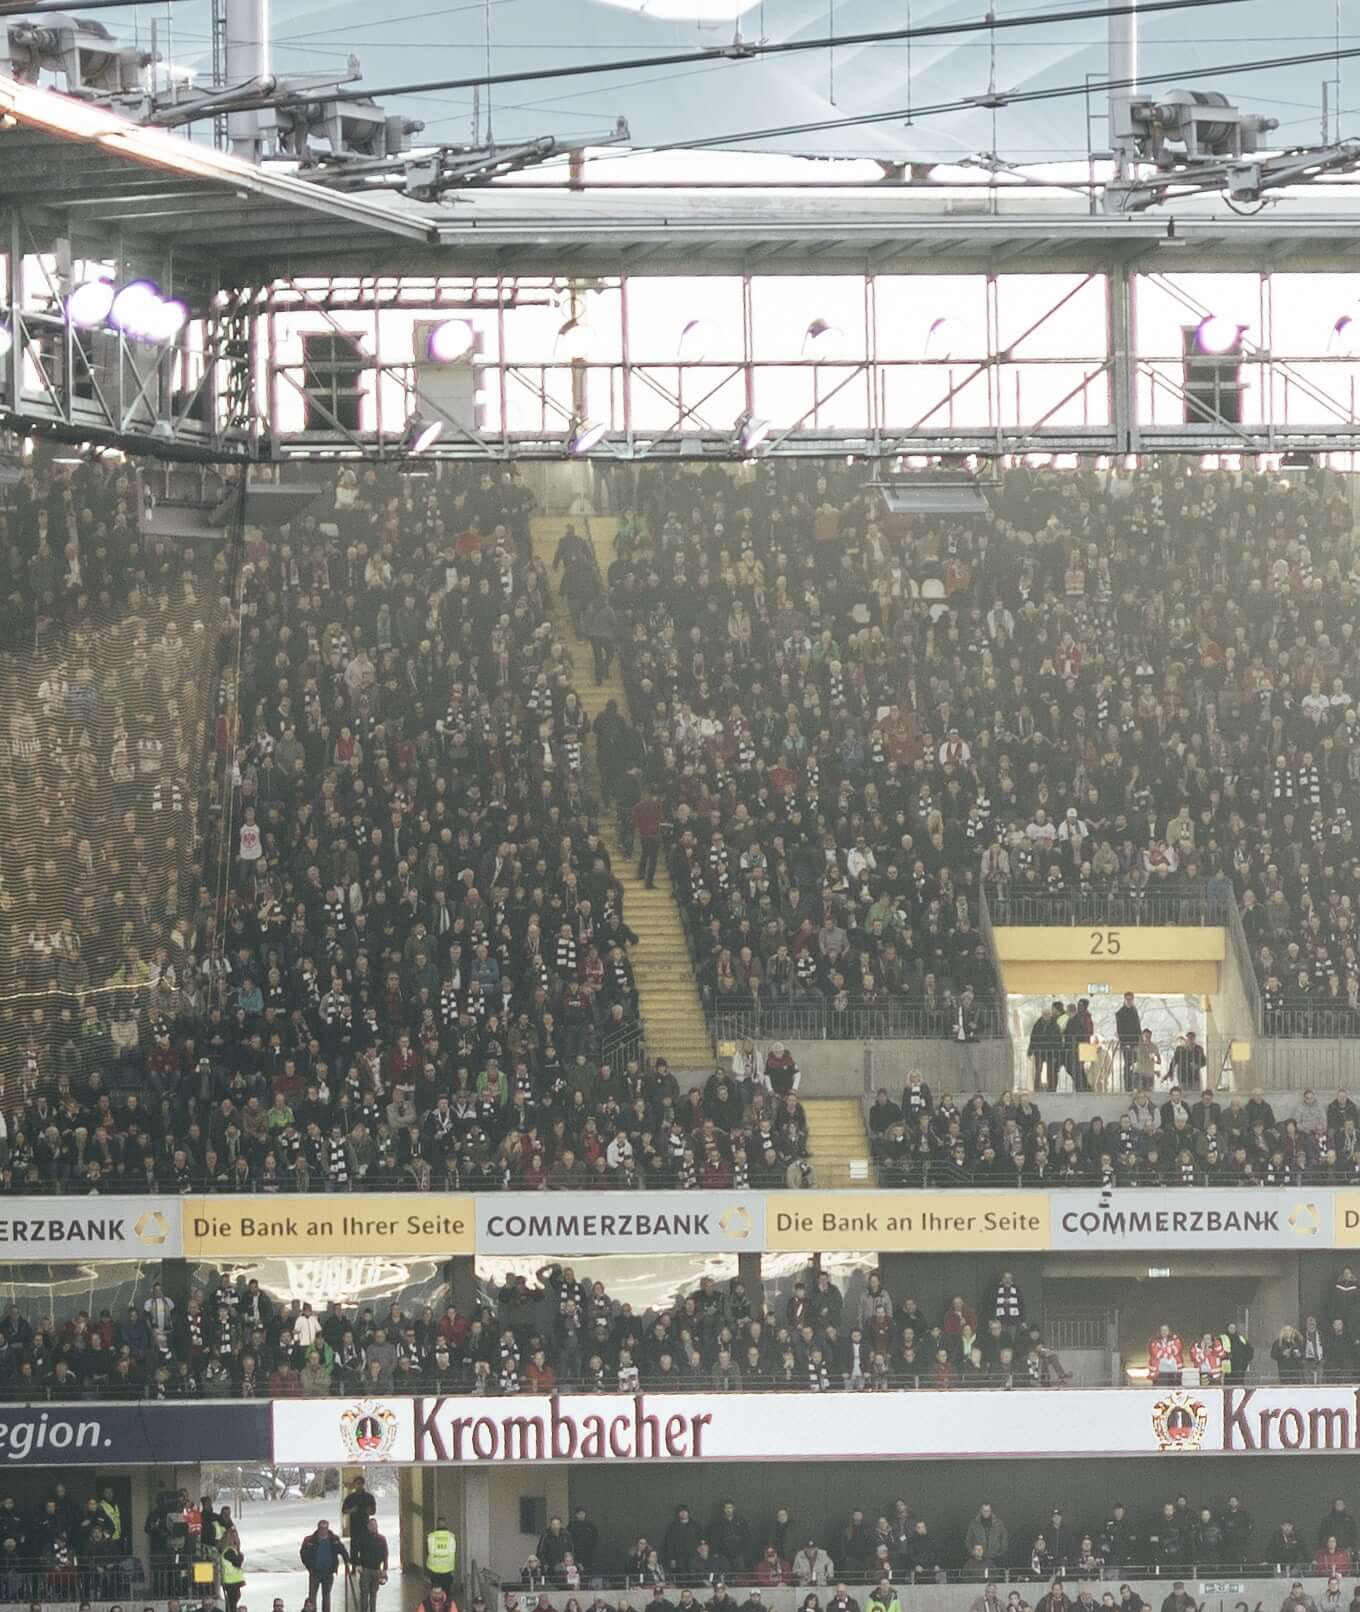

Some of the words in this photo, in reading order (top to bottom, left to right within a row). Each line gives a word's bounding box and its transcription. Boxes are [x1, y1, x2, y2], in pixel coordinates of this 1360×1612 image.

[1089, 931, 1122, 956] 25
[194, 1218, 231, 1237] Die
[241, 1217, 297, 1237] Bank
[306, 1220, 333, 1236] an
[344, 1217, 400, 1236] Ihrer
[407, 1215, 465, 1235] Seite
[486, 1214, 710, 1237] COMMERZBANK
[777, 1213, 813, 1232] Die
[822, 1212, 878, 1232] Bank
[886, 1216, 912, 1232] an
[922, 1212, 976, 1232] Ihrer
[984, 1211, 1040, 1231] Seite
[1062, 1210, 1279, 1233] COMMERZBANK
[413, 1393, 713, 1462] Krombacher
